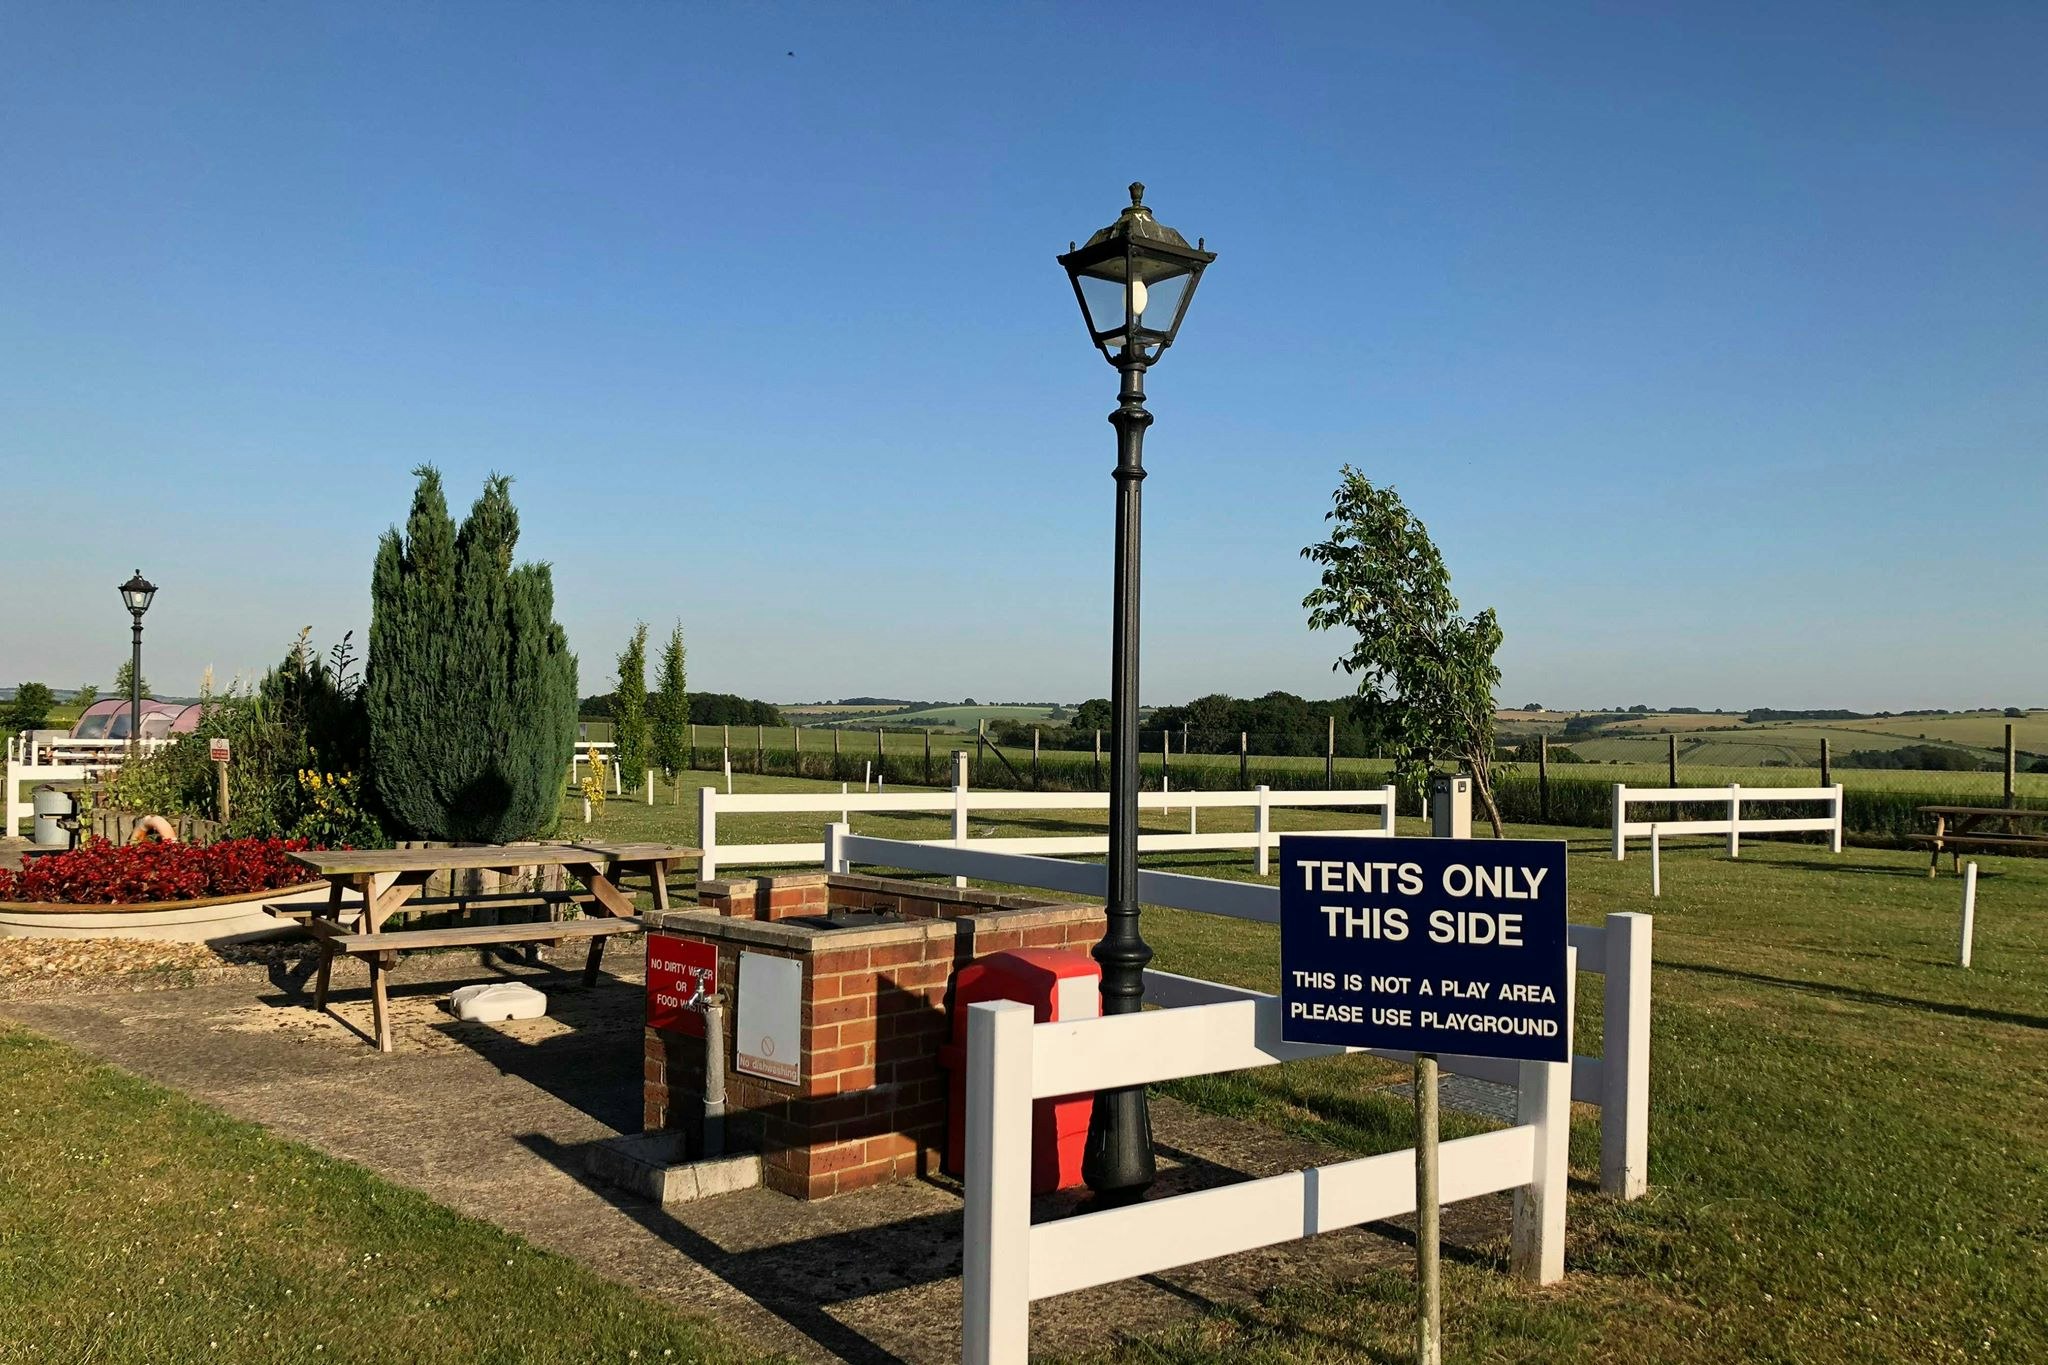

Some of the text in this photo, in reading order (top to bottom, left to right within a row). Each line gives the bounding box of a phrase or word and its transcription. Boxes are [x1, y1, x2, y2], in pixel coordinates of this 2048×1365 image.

[1297, 860, 1548, 899] TENTS ONLY
[1320, 906, 1523, 946] THIS SIDE
[651, 958, 662, 969] NO
[665, 961, 686, 974] DIRTY
[657, 994, 678, 1007] FOOD
[676, 981, 687, 992] OR
[1293, 971, 1556, 1003] THIS IS NOT A PLAY AREA
[1291, 1002, 1558, 1037] PLEASE USE PLAYGROUND
[740, 1055, 797, 1081] No dishwashing
